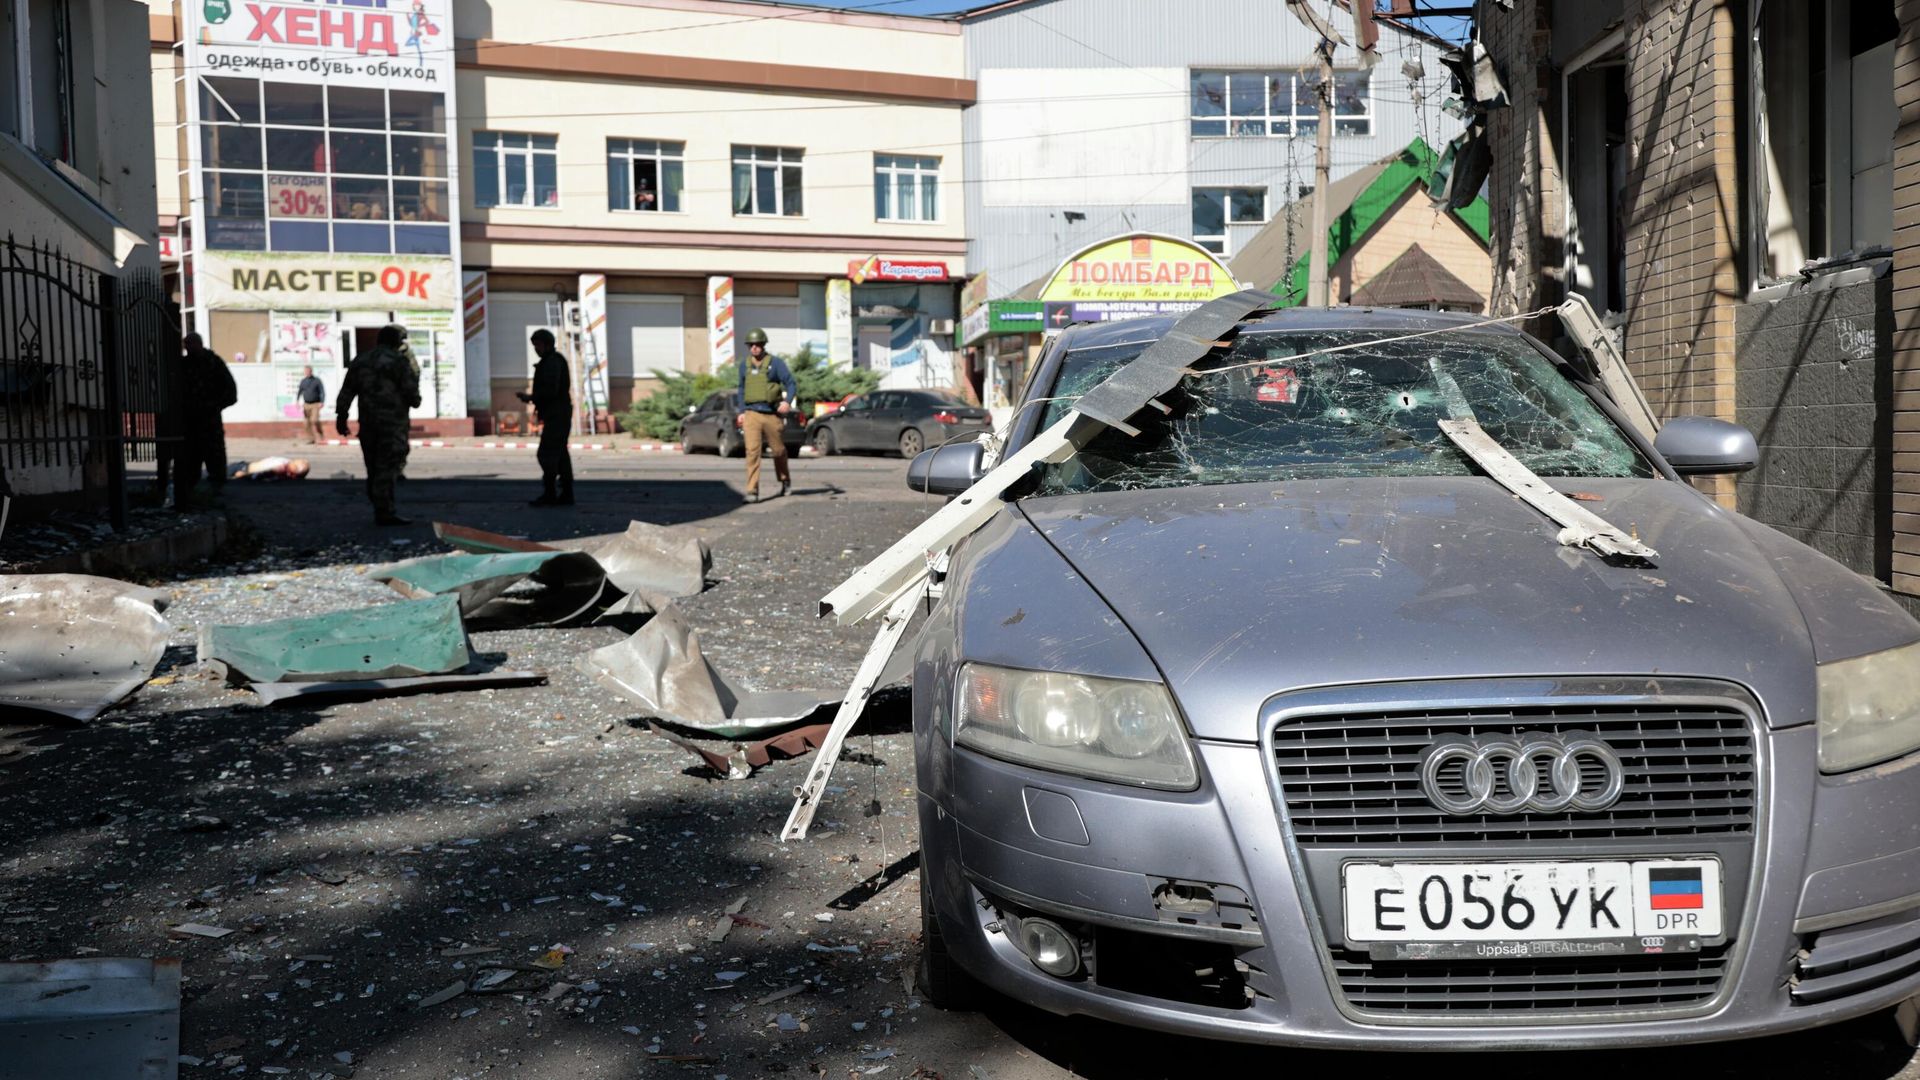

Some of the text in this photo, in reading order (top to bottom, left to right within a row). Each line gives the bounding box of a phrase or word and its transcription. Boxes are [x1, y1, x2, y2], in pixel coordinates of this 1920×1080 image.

[245, 3, 399, 57] ХЕНД
[206, 53, 437, 81] одежда обувь обиход
[270, 176, 325, 187] СЕГОДНЯ
[271, 189, 326, 215] -30%
[232, 266, 430, 300] МАСТЕРОК
[1069, 261, 1213, 287] ЛОМБАРД
[1656, 912, 1698, 930] DPR
[1476, 943, 1528, 956] Uppsala
